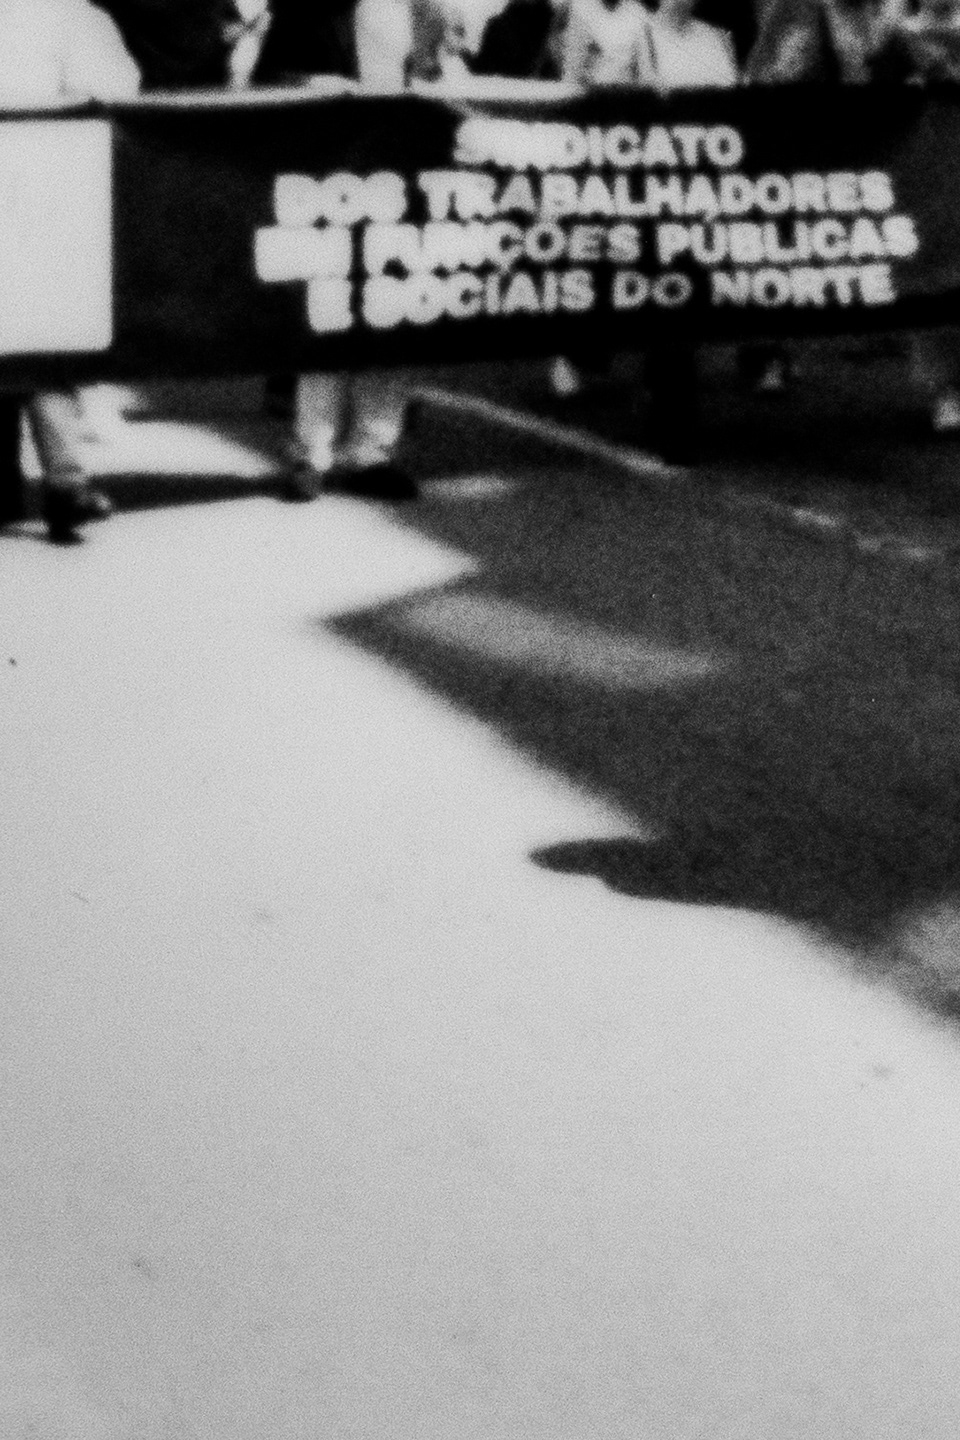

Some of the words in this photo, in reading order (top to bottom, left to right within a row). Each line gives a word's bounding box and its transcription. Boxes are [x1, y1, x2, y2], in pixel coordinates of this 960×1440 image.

[454, 118, 743, 170] SDICATO
[418, 169, 895, 222] TRABALHADORES
[612, 271, 693, 309] DO
[712, 263, 897, 306] NORTE
